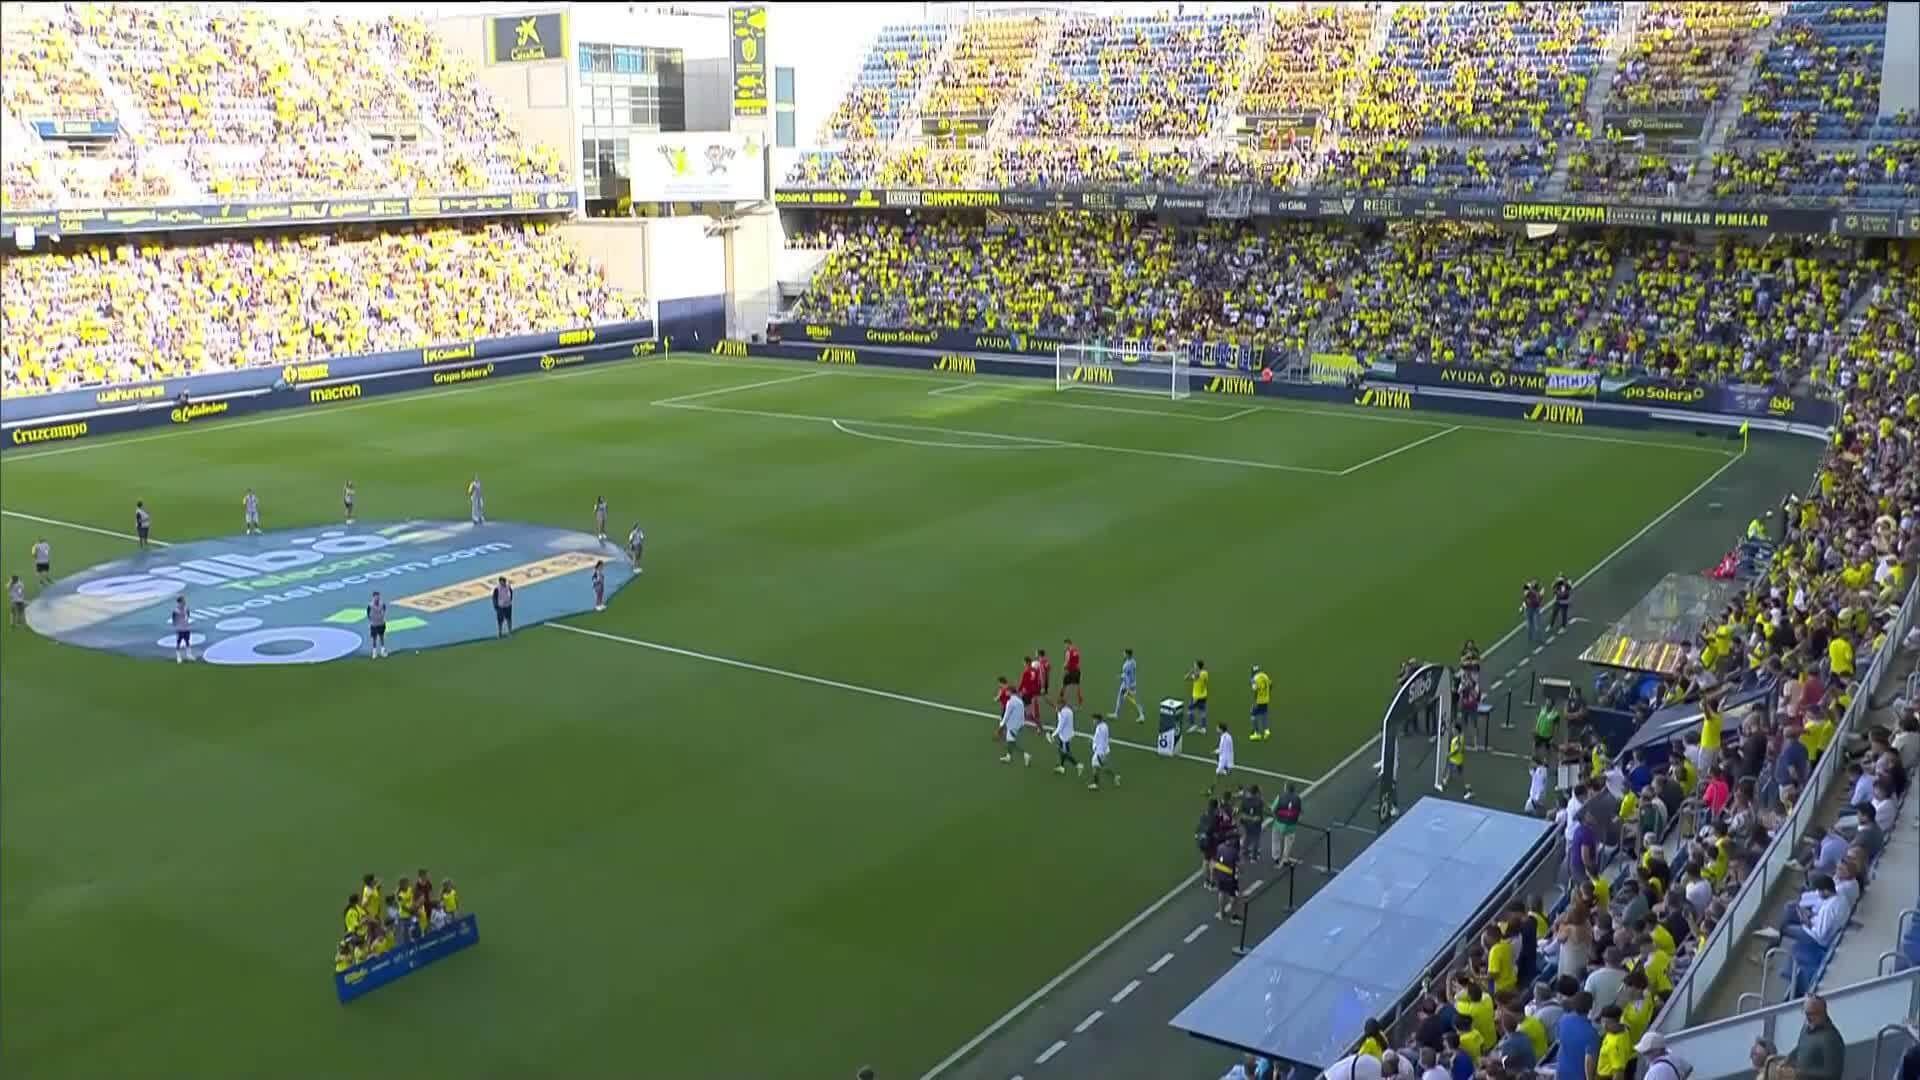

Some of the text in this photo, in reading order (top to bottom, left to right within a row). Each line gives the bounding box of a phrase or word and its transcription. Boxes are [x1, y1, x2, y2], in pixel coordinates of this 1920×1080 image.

[1518, 203, 1605, 223] IMPREZIONA
[866, 329, 931, 344] Grupo Solera
[975, 336, 1011, 348] AYUDA
[724, 340, 748, 357] JOYMA
[831, 347, 856, 365] JOYMA
[948, 354, 977, 374] JOYMA
[433, 368, 488, 385] Grupo Solera
[1082, 365, 1114, 384] JOYMA
[1440, 369, 1545, 389] AYUDA PYME
[310, 384, 361, 403] macron
[1221, 377, 1255, 395] JOYMA
[1647, 385, 1693, 402] Solera
[1373, 389, 1410, 409] JOYMA
[1543, 404, 1584, 425] JOYMA
[13, 421, 88, 445] Cruzcampo
